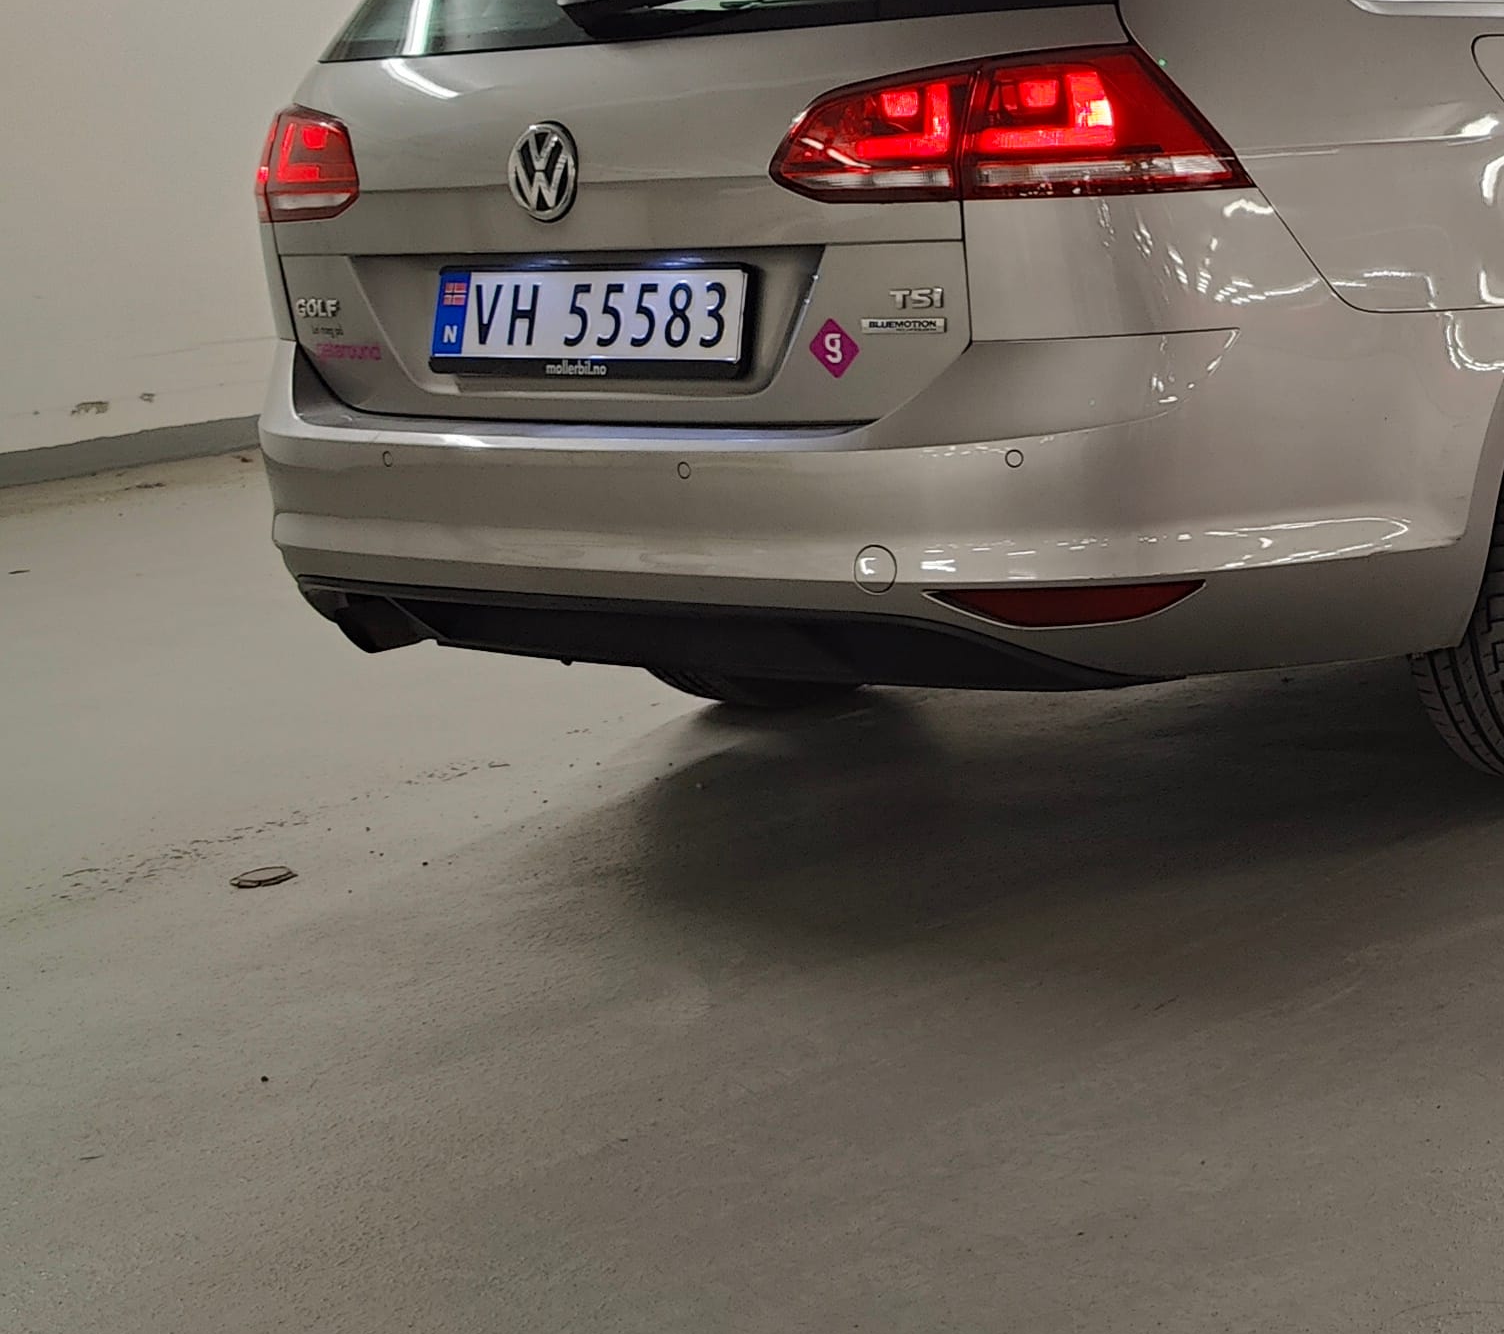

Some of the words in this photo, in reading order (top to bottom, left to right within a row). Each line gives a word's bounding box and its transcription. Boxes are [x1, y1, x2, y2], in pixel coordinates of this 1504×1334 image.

[296, 297, 340, 318] GOLF
[888, 286, 944, 310] TSI
[475, 283, 541, 347] VH
[563, 281, 727, 349] 55583
[868, 319, 938, 329] BLUEMOTION
[442, 324, 459, 344] N
